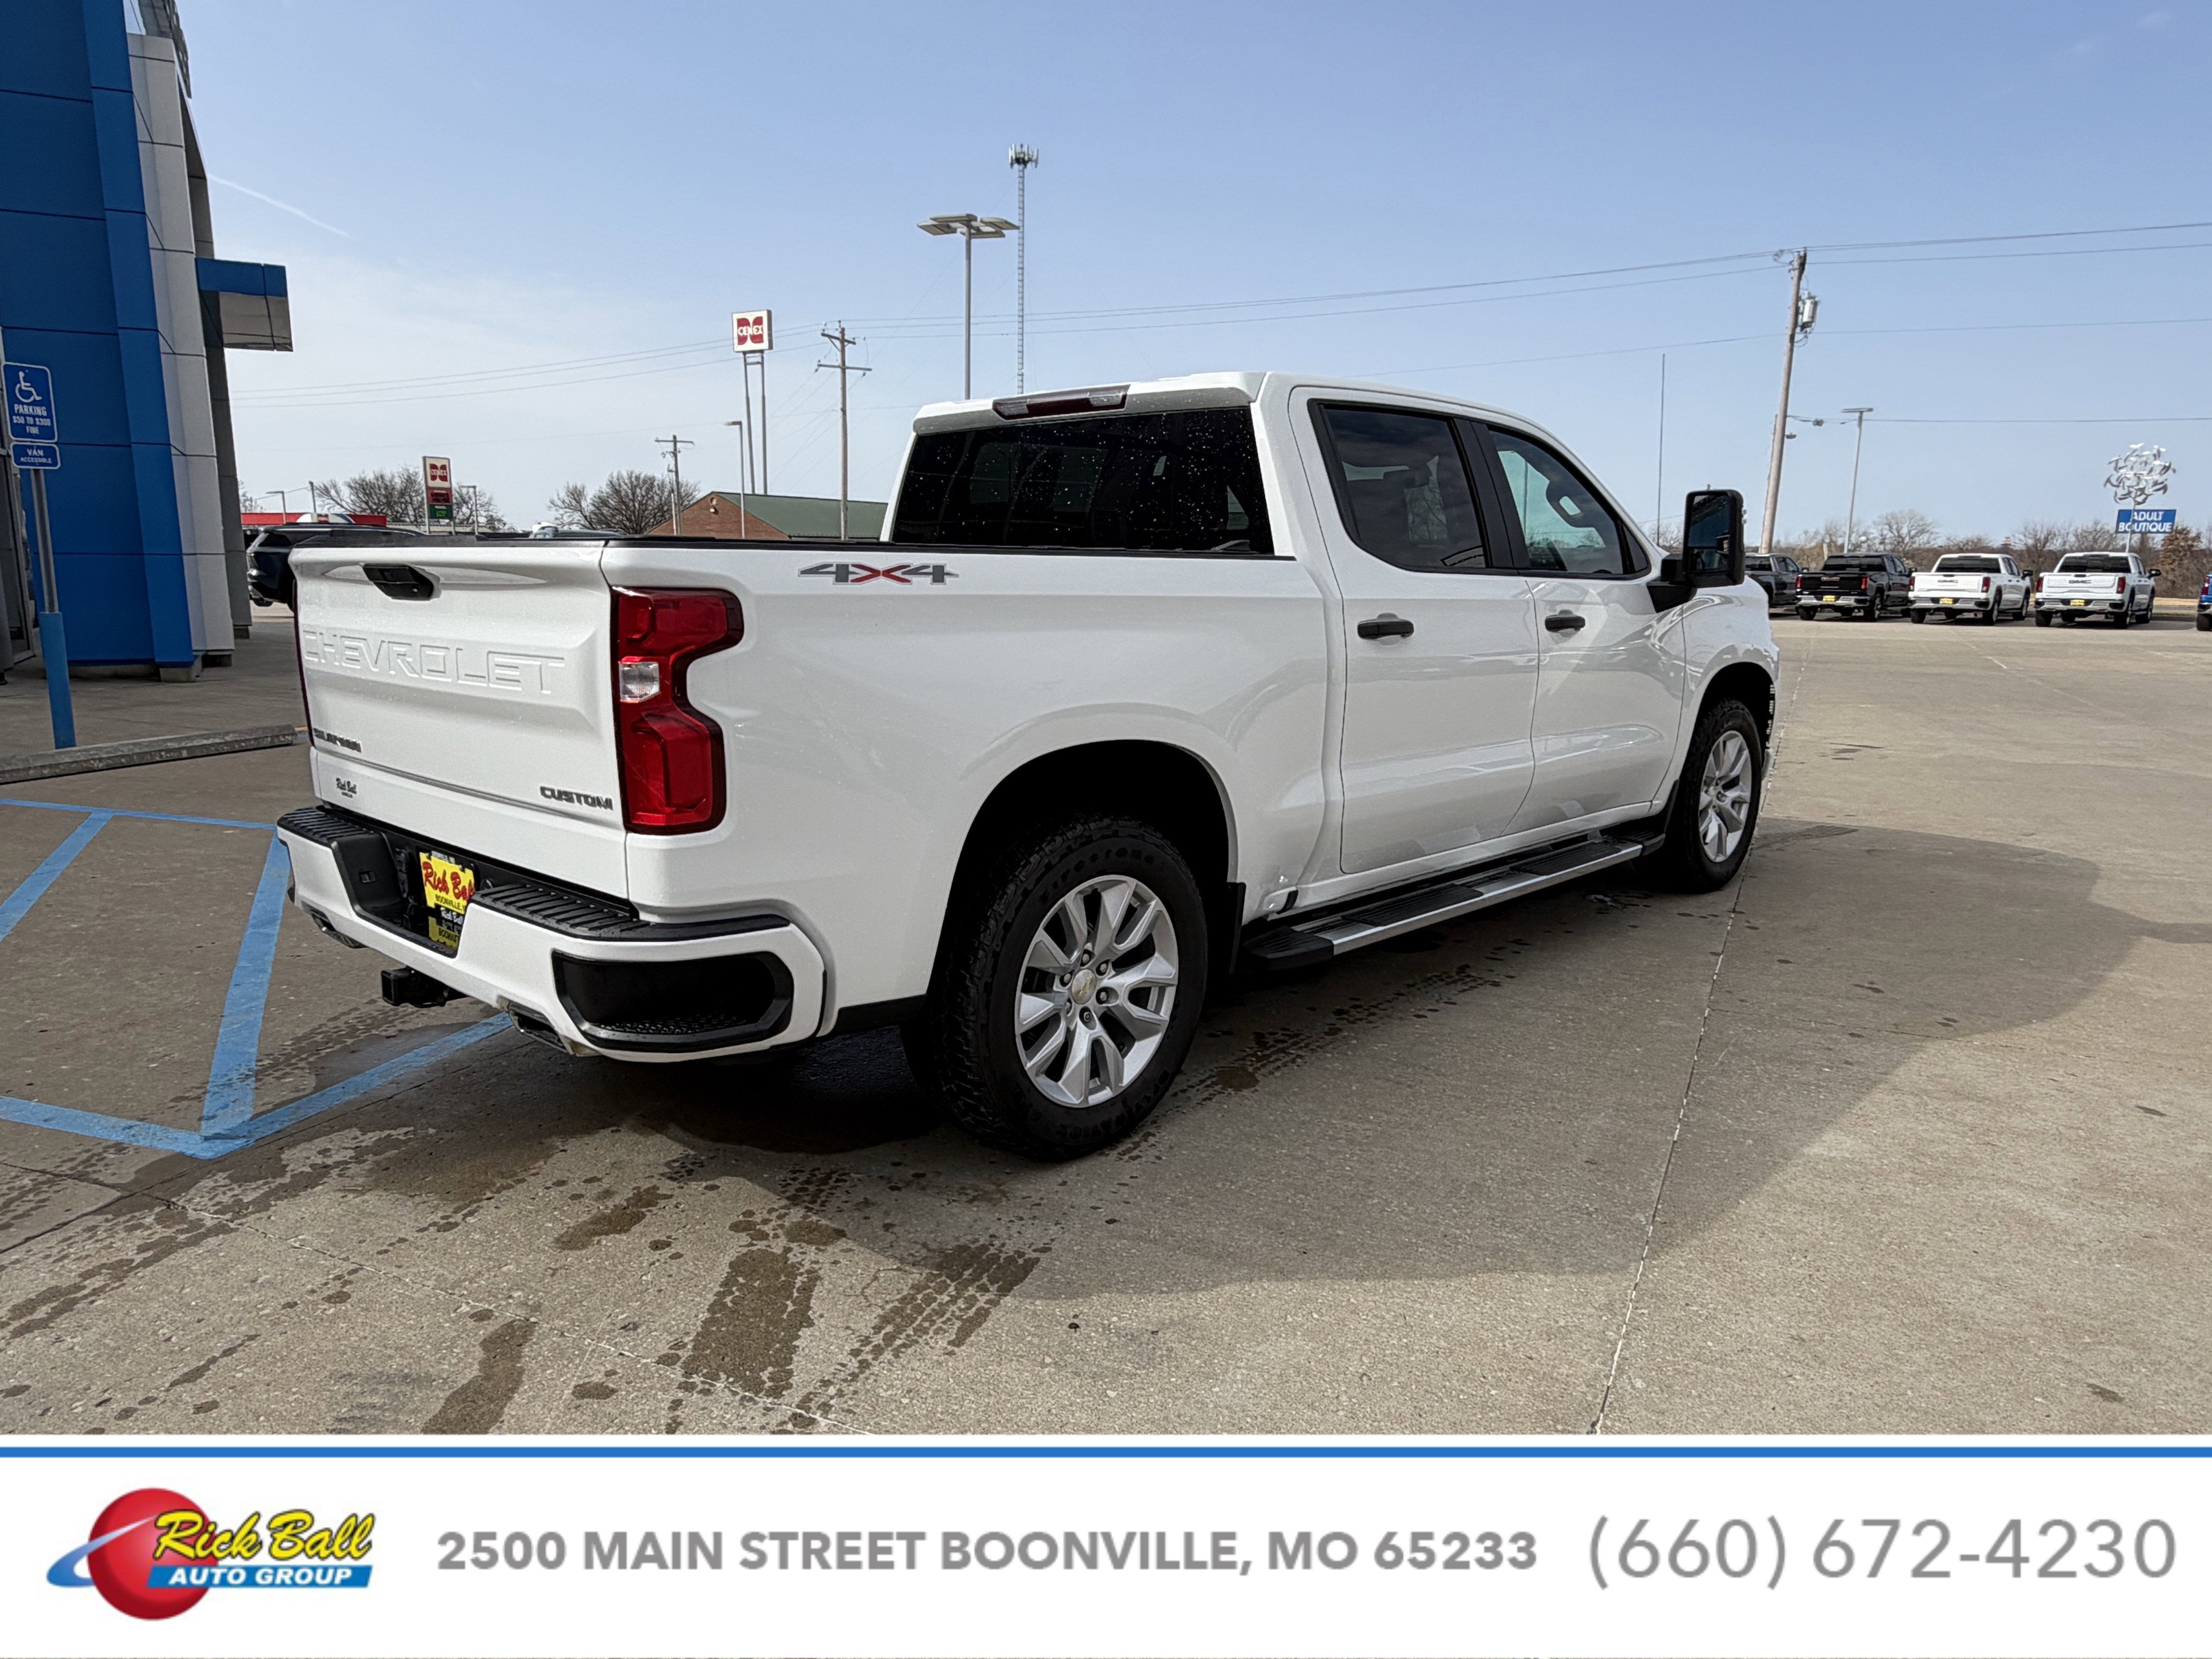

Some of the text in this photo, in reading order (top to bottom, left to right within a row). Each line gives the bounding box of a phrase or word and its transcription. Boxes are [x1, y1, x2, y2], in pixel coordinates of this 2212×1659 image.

[14, 404, 47, 416] PARKING
[12, 415, 51, 426] $50 TO $300
[26, 426, 40, 434] FINE
[2130, 511, 2164, 521] ADULT
[2118, 522, 2172, 532] BOUTIQUE
[303, 630, 565, 694] CHEVROLET
[540, 786, 613, 811] CUSTOM
[422, 861, 449, 895] Rick
